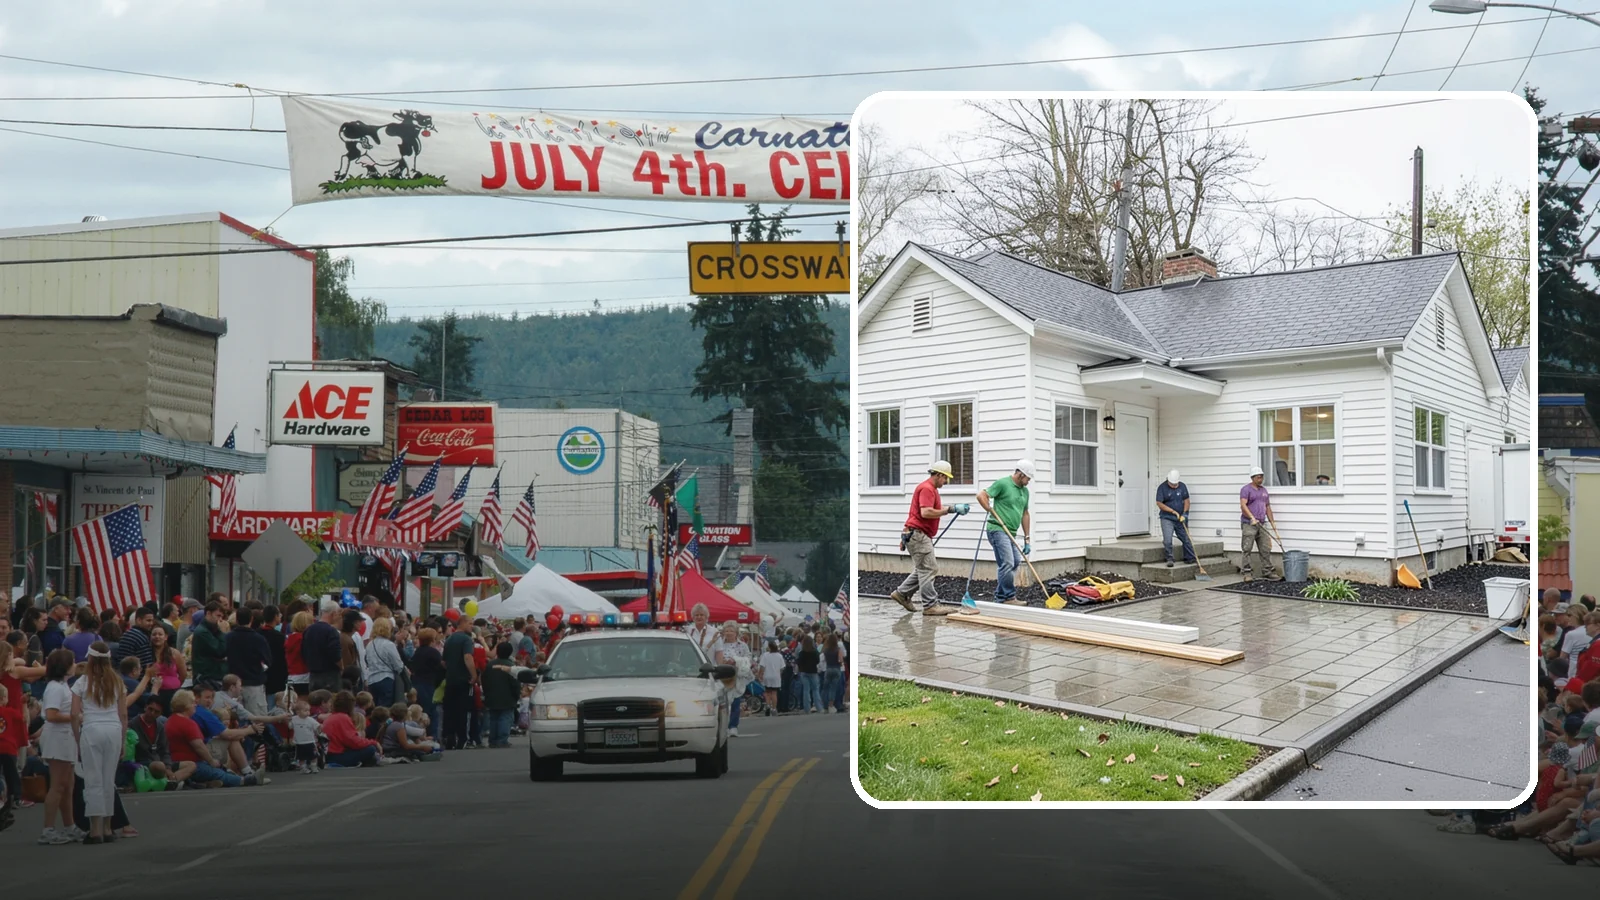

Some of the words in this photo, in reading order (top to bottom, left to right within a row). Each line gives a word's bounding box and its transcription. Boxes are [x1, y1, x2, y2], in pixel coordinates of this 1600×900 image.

[481, 141, 605, 192] JULY
[632, 149, 747, 198] 4th.
[697, 254, 850, 279] CROSSWA
[282, 380, 373, 420] ACE
[405, 409, 453, 422] CEDAR
[283, 421, 371, 437] Hardware
[416, 428, 477, 447] Coca-Cola
[354, 467, 385, 481] Simpl
[83, 485, 93, 494] St.
[95, 485, 124, 495] Vincent
[126, 486, 136, 495] de
[137, 486, 155, 496] Paul
[688, 526, 741, 535] CRNATION
[699, 535, 731, 543] GLASS
